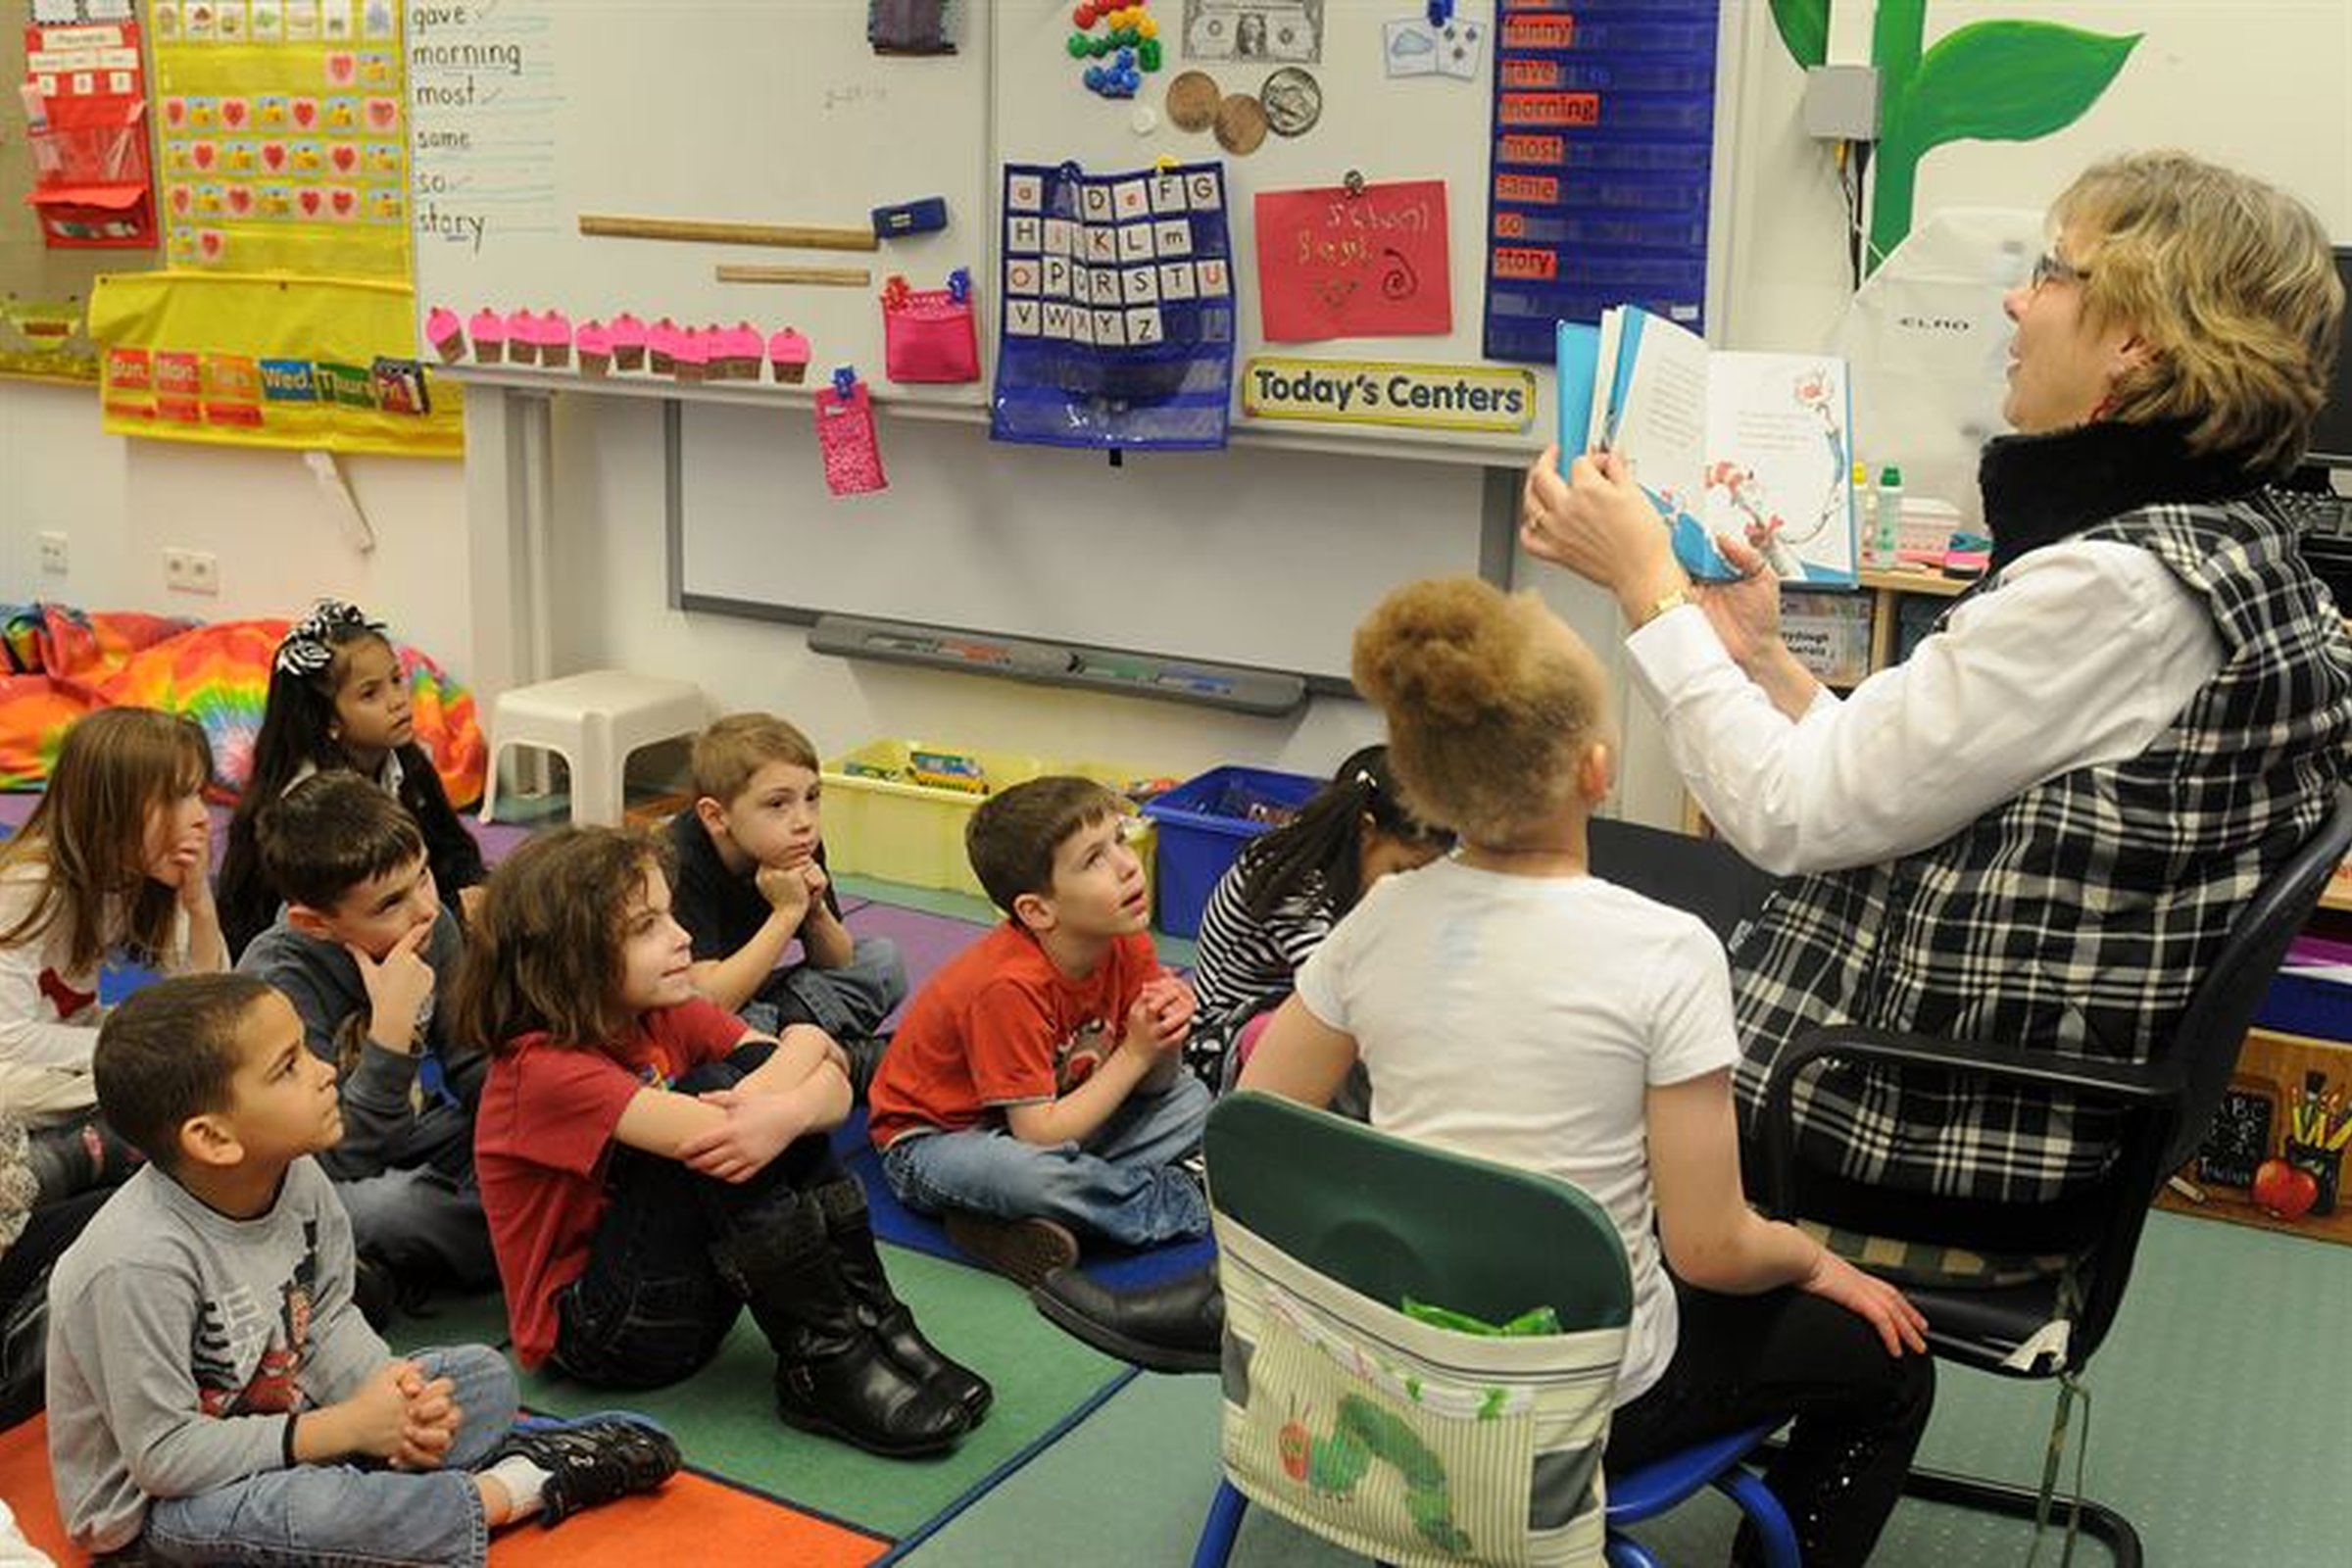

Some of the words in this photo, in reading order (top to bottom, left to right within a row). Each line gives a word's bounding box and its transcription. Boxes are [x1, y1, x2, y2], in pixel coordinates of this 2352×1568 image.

[412, 6, 466, 34] gave
[413, 44, 521, 75] morning
[416, 74, 473, 106] most
[1501, 96, 1594, 122] morning
[419, 172, 445, 193] so
[1088, 189, 1105, 211] D
[1193, 177, 1212, 199] G
[1497, 175, 1554, 198] same
[418, 202, 484, 254] story
[1016, 221, 1035, 242] H
[1094, 230, 1108, 251] K
[1128, 229, 1142, 251] L
[1497, 215, 1520, 234] so
[1495, 249, 1551, 274] story
[1052, 263, 1065, 288] P
[1097, 273, 1111, 293] R
[1133, 271, 1148, 292] S
[1169, 268, 1184, 288] T
[1205, 264, 1222, 285] U
[1015, 305, 1032, 323] V
[1099, 315, 1113, 333] Y
[1138, 319, 1152, 340] Z
[264, 368, 313, 390] Wed.
[1255, 369, 1378, 411] Today's
[1388, 376, 1523, 413] Centers
